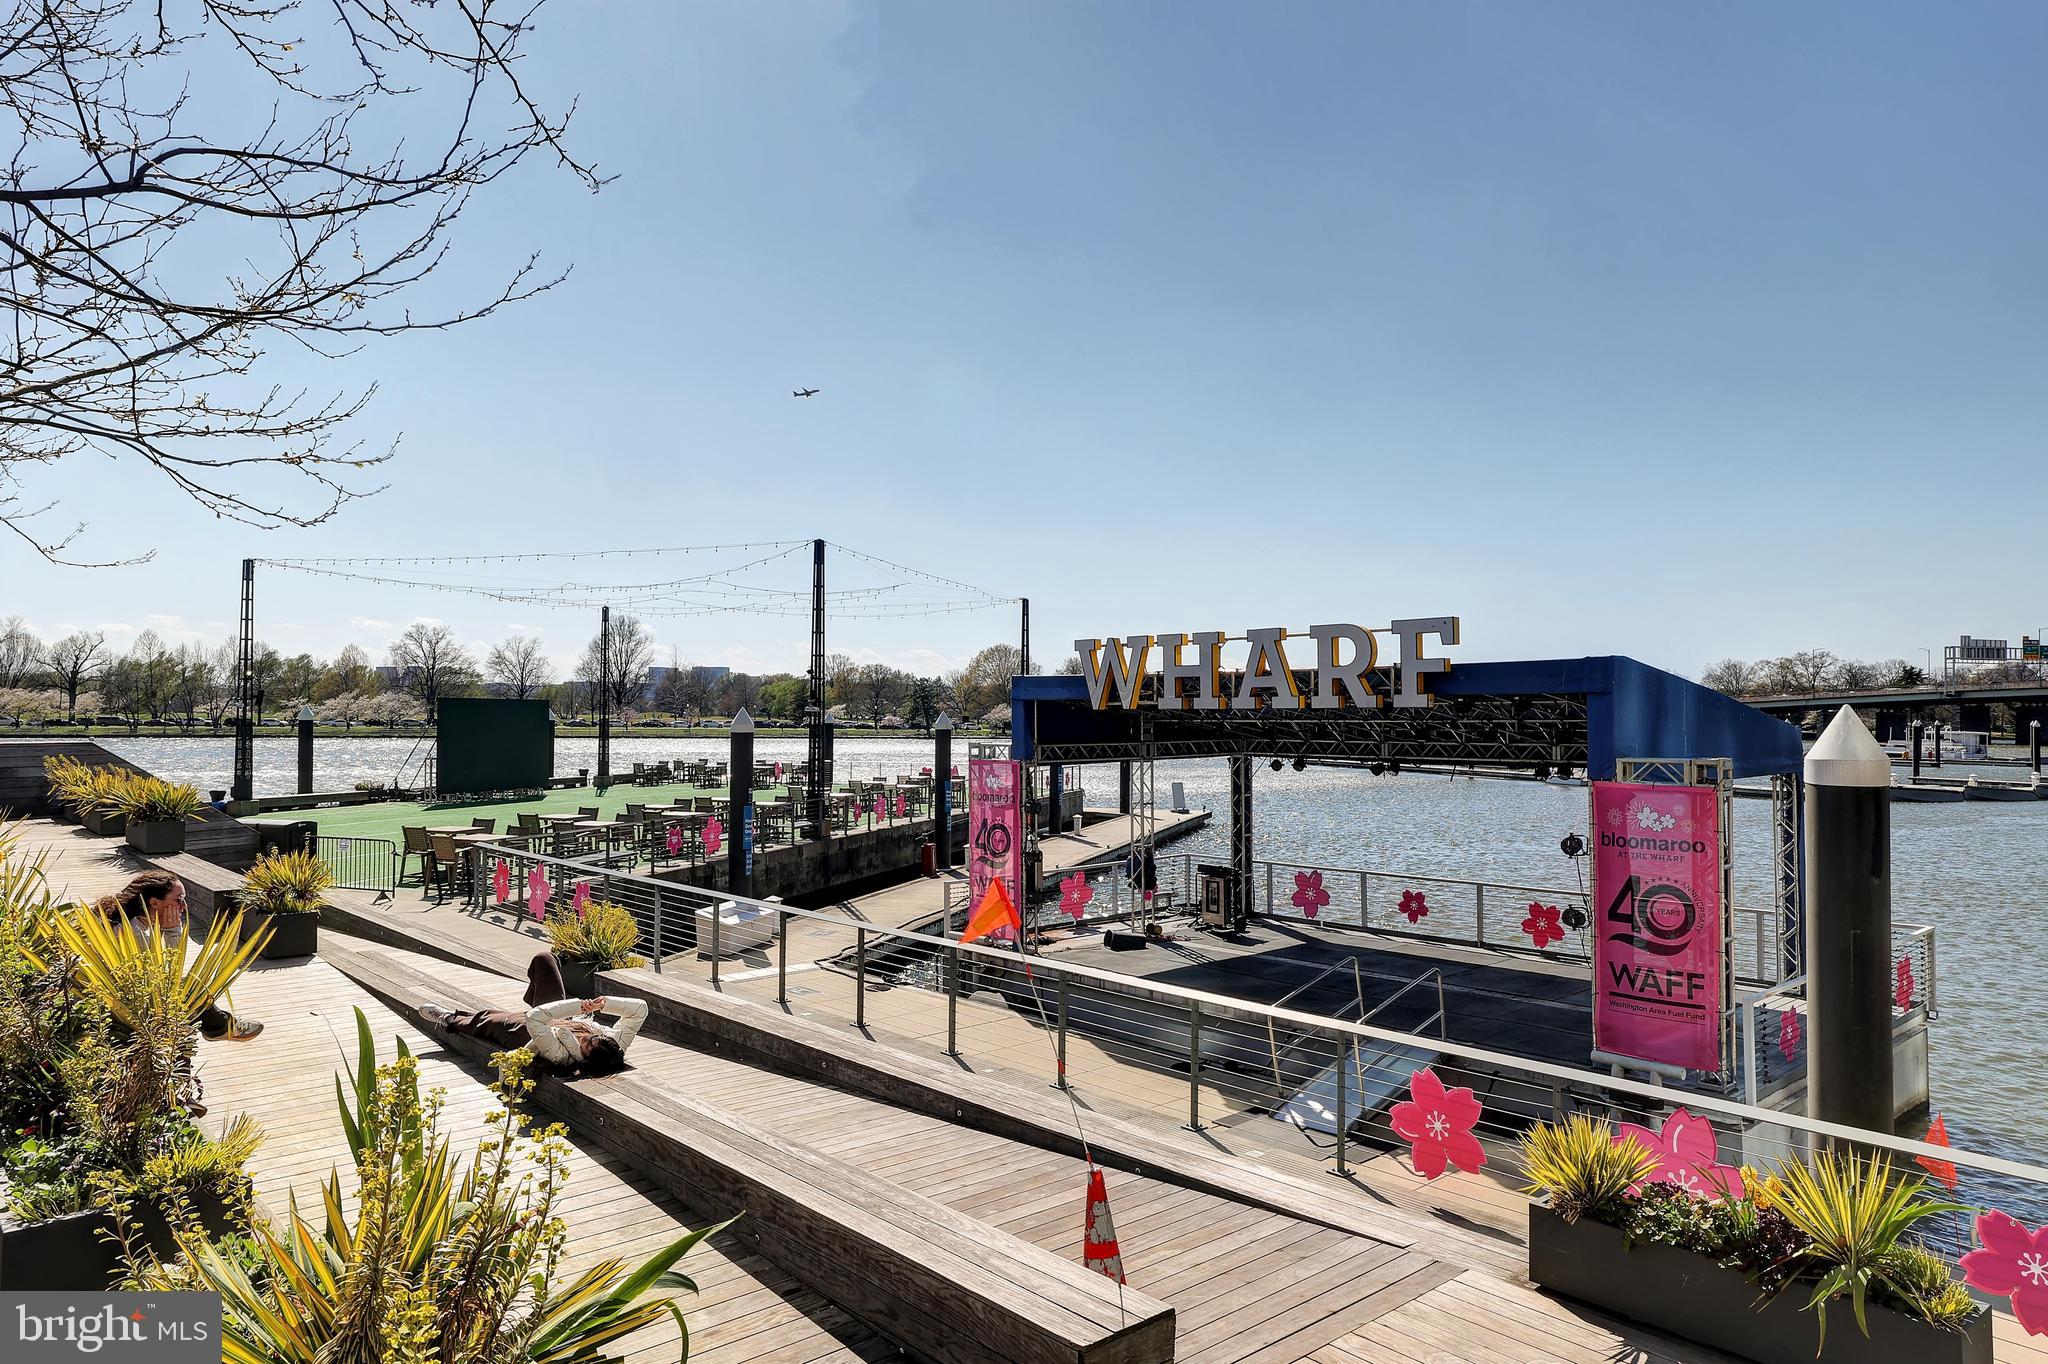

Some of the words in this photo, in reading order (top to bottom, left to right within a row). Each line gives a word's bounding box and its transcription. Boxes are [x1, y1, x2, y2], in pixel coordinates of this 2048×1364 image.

[1074, 616, 1460, 710] WHARF
[975, 817, 1011, 858] 40
[1601, 831, 1706, 854] bloomaroo
[1630, 852, 1647, 860] THE
[1650, 854, 1686, 863] WHARF
[975, 875, 1015, 895] WF
[1608, 874, 1696, 940] 40
[1656, 907, 1681, 917] YEARS
[1680, 881, 1706, 934] ANNIVERSARY
[1608, 960, 1705, 1000] WAFF
[1609, 1000, 1648, 1012] Washington
[1649, 1007, 1666, 1015] Area
[1668, 1009, 1684, 1018] Fuel
[1685, 1012, 1705, 1020] Fund
